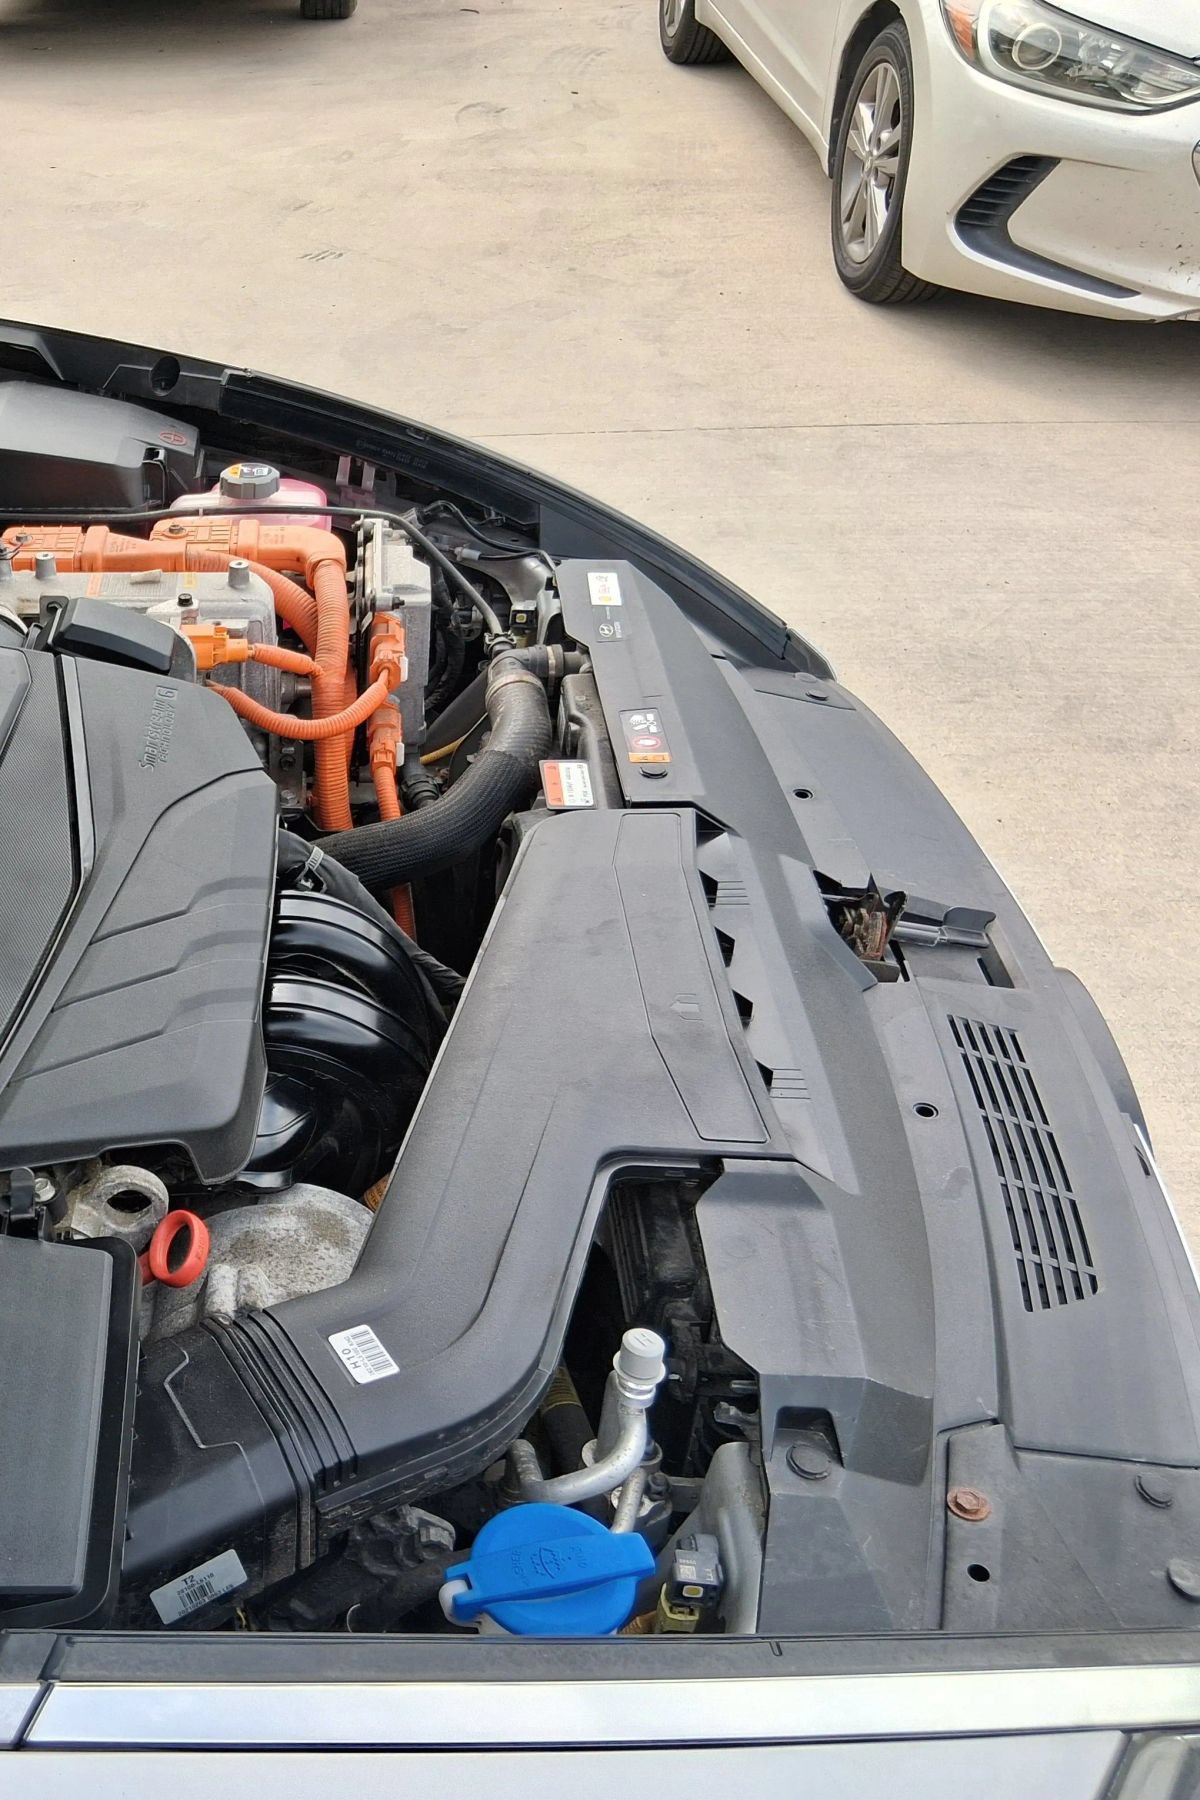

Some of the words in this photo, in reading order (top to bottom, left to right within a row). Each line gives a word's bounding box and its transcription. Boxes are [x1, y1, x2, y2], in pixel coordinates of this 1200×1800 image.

[138, 699, 166, 772] Smartstream
[341, 1348, 362, 1370] H10
[182, 1574, 196, 1586] T2
